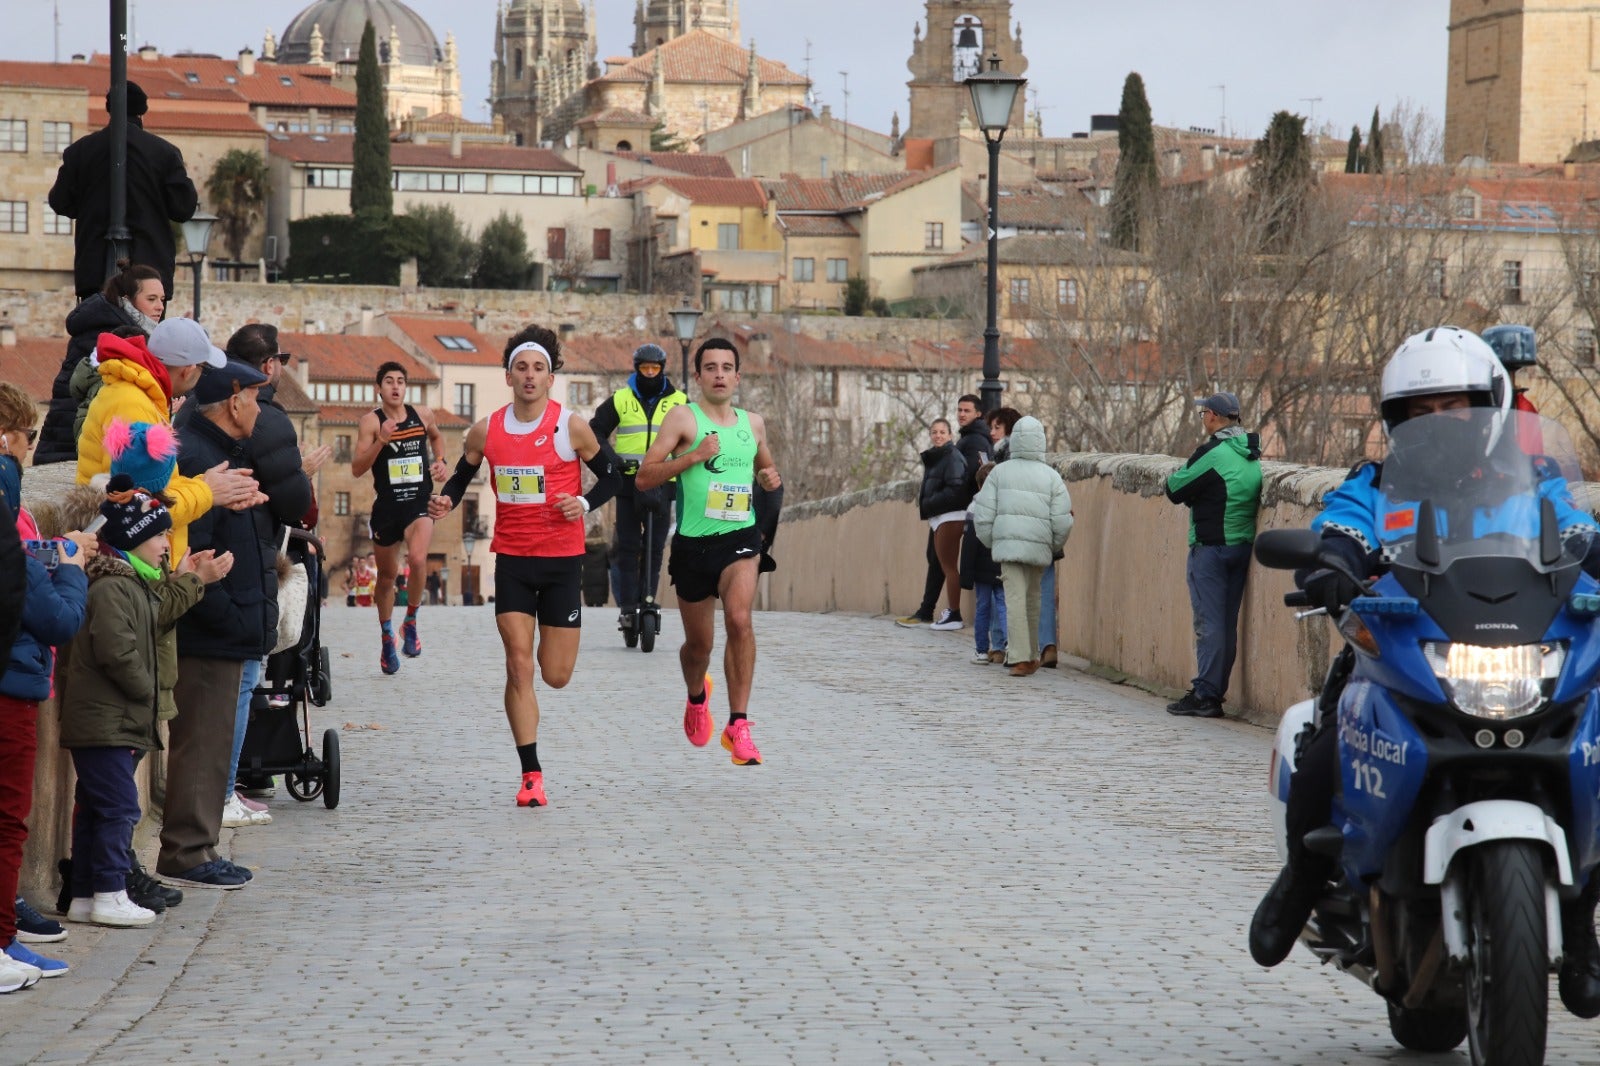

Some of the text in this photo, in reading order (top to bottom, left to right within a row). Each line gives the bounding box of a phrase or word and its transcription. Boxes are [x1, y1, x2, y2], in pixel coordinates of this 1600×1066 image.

[623, 400, 686, 415] JUE
[400, 465, 409, 475] 12
[512, 476, 520, 490] 3
[725, 493, 734, 508] 5
[126, 511, 158, 538] MERRY
[1371, 731, 1408, 765] Local
[1351, 759, 1386, 799] 112
